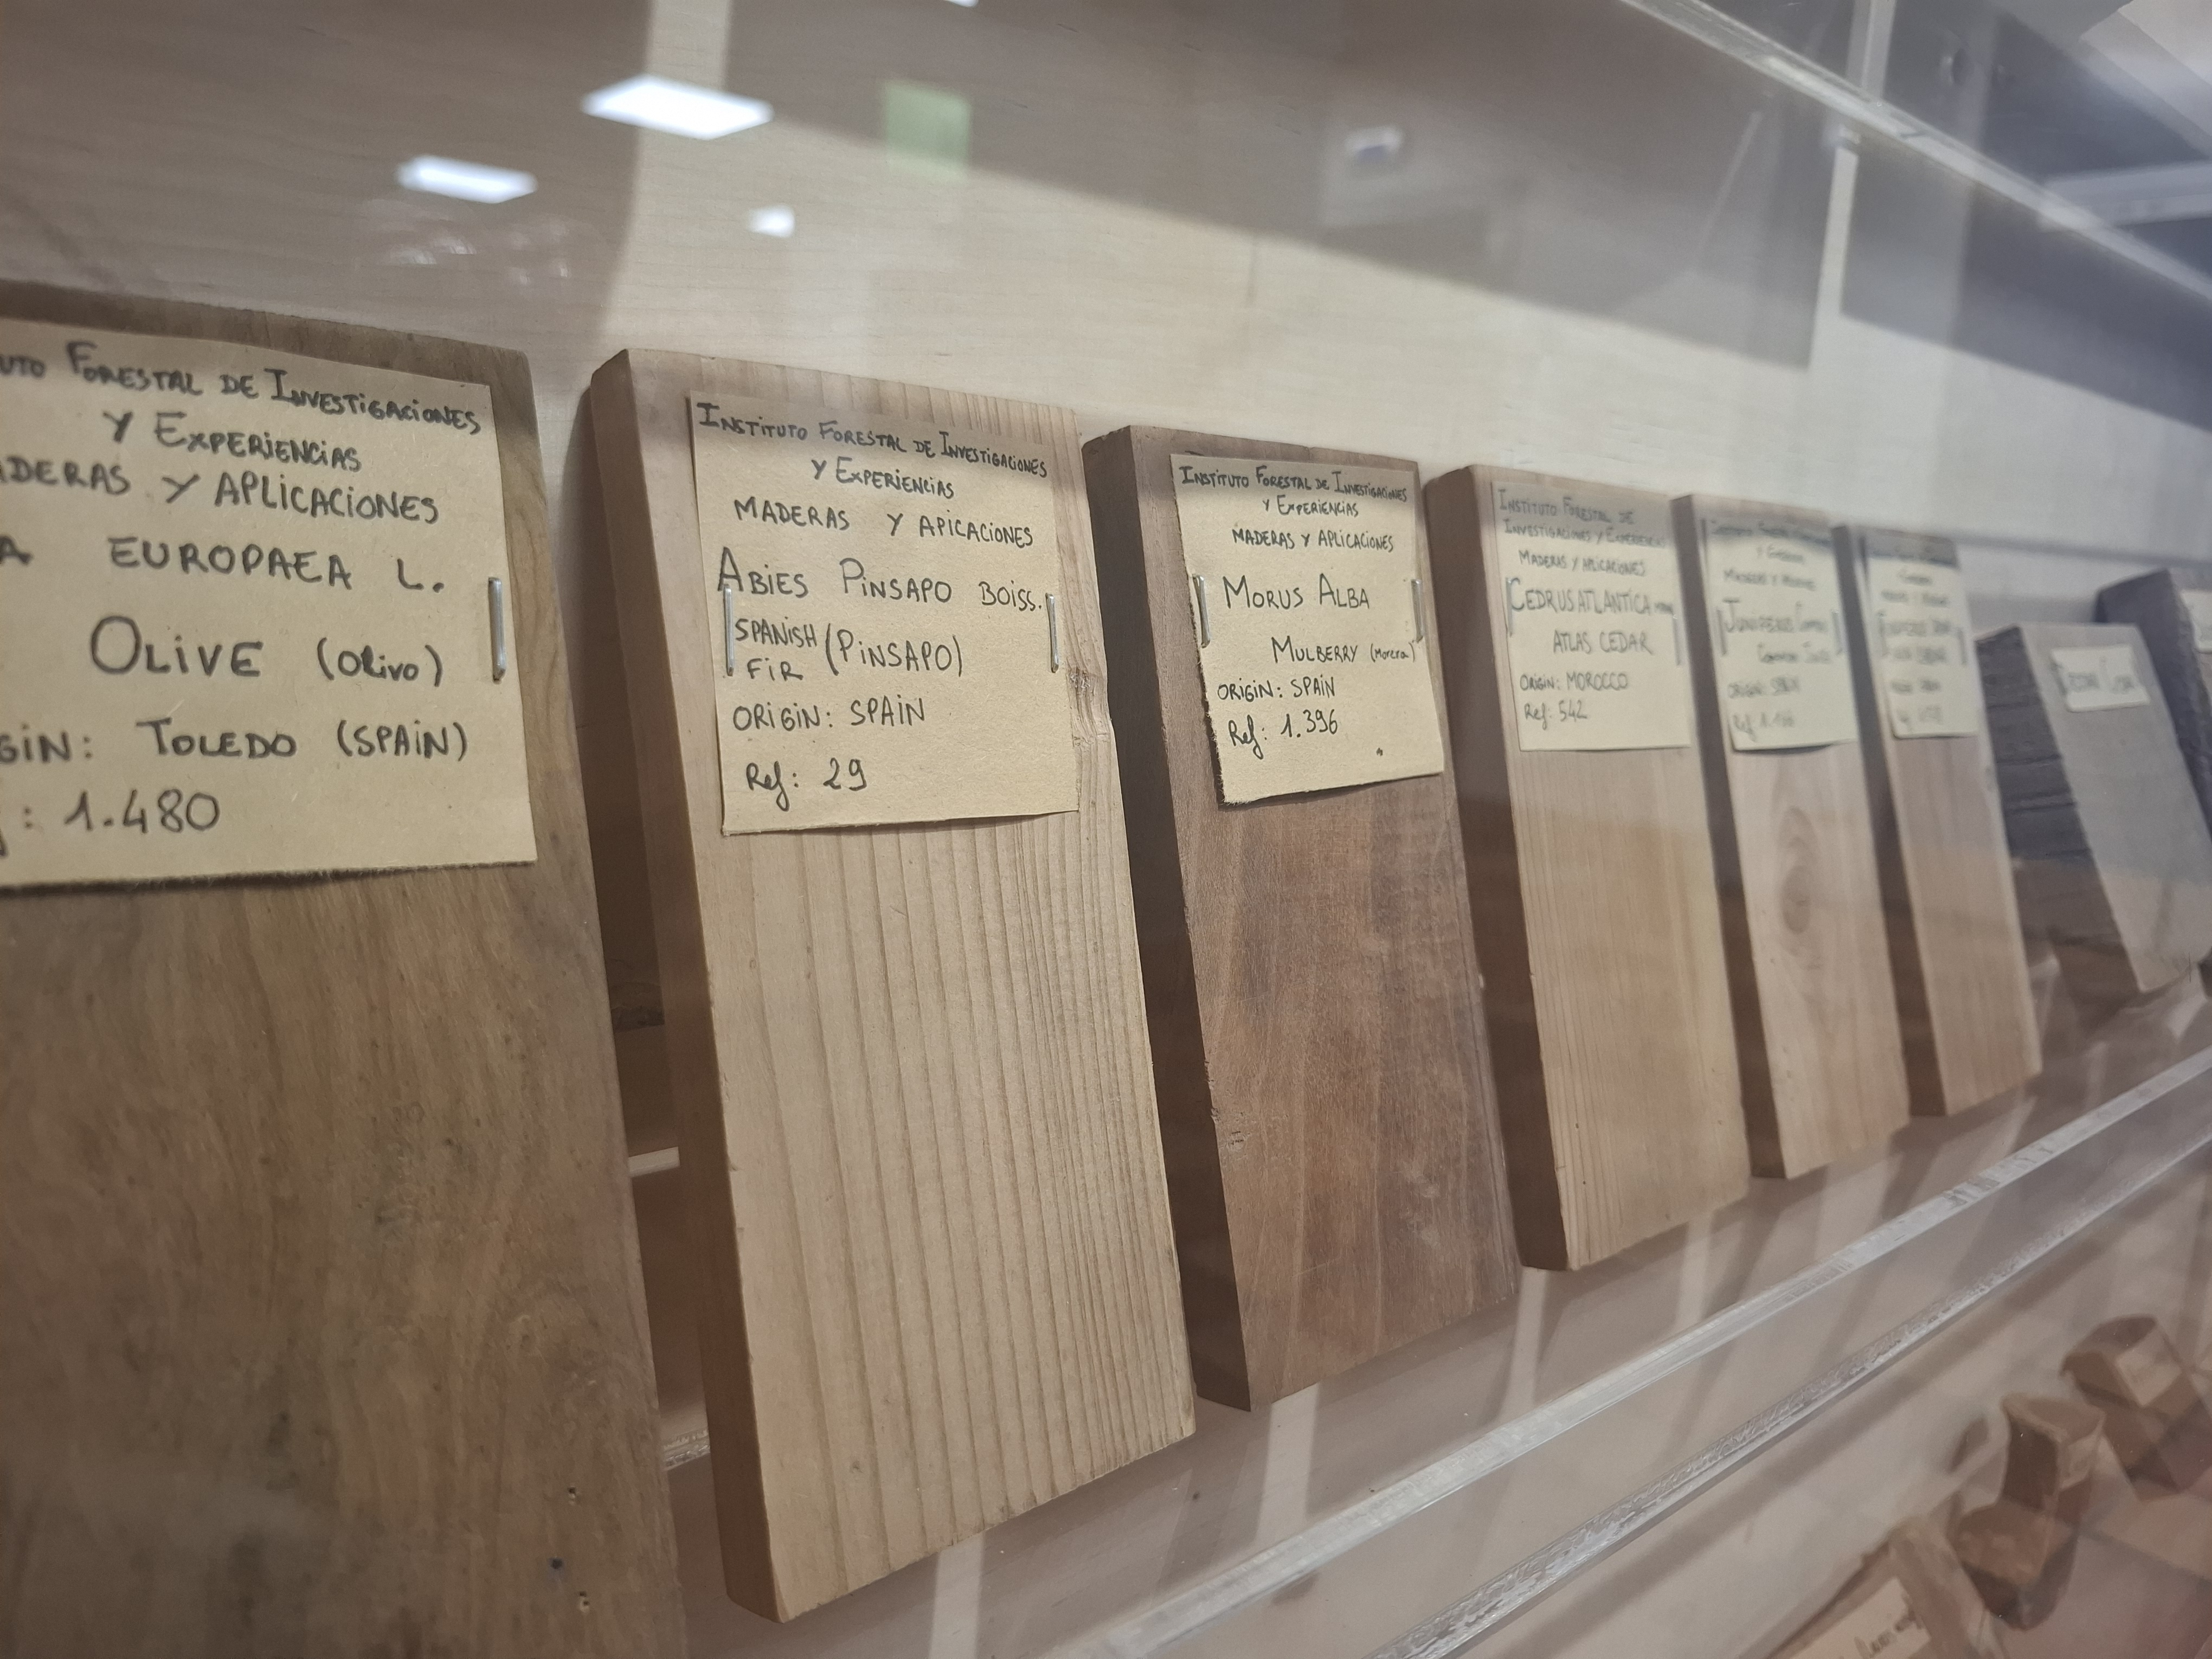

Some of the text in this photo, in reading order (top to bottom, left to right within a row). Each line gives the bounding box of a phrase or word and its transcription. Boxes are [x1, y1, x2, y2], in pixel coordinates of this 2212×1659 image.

[66, 340, 203, 396] FORESTAL
[220, 372, 259, 399] DE
[103, 410, 133, 443] Y
[818, 420, 907, 453] FORESTAL
[913, 440, 936, 458] DE
[811, 458, 827, 480] Y
[1255, 465, 1311, 490] FORESTAL
[1315, 478, 1330, 491] DE
[162, 474, 200, 504] Y
[734, 496, 850, 531] MADERAS
[885, 513, 904, 537] Y
[1232, 528, 1295, 550] MADERAS
[1300, 533, 1310, 548] Y
[108, 536, 352, 590] EUROPAEA
[396, 557, 445, 594] L.
[1222, 573, 1370, 610] MORUS ALBA
[1271, 635, 1358, 664] MULBERRY
[1553, 629, 1655, 655] ATLAS CEDAR
[1566, 672, 1628, 691] MOROCCO
[1281, 709, 1338, 738] 1.396
[1558, 699, 1588, 722] 542
[136, 716, 298, 758] TOLEDO
[822, 757, 868, 792] 29
[63, 788, 221, 834] 1.480
